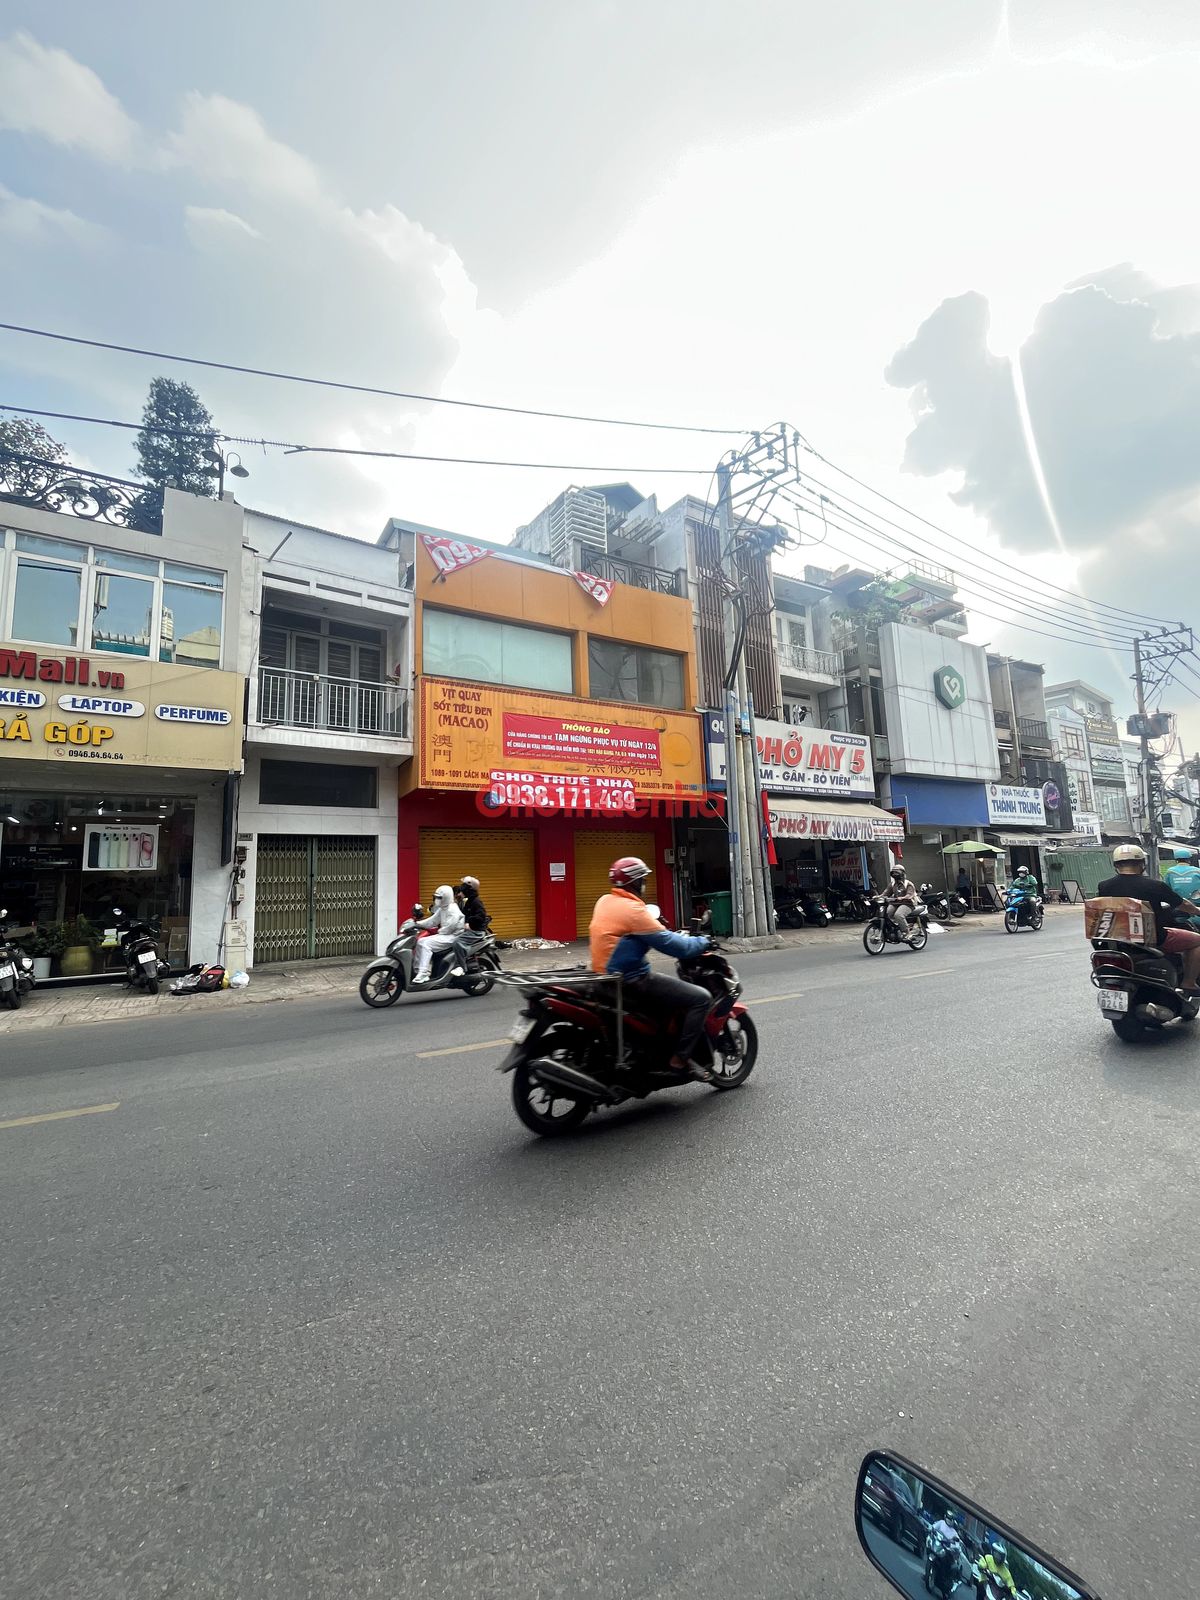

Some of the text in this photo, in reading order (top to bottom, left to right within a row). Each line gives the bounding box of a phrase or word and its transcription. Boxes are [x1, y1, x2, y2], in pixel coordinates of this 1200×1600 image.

[442, 688, 482, 701] VỊT QUAY
[71, 698, 133, 713] LAPTOP
[159, 706, 228, 722] PERFUME
[433, 699, 451, 711] SỐT
[475, 707, 492, 716] ĐEN
[0, 711, 114, 746] Ả GÓP
[438, 713, 489, 732] (MACAO)
[555, 733, 569, 742] TẠM
[807, 743, 846, 771] MY
[850, 748, 865, 774] 5
[490, 771, 534, 783] CHO
[540, 774, 590, 786] THUÊ
[596, 778, 634, 788] NHÀ
[490, 783, 636, 810] 0938.171.439
[1001, 787, 1030, 798] NHÀ THUỐC
[992, 798, 1041, 814] THÀNH TRUNG
[778, 814, 808, 834] PHỞ
[810, 820, 831, 835] MY
